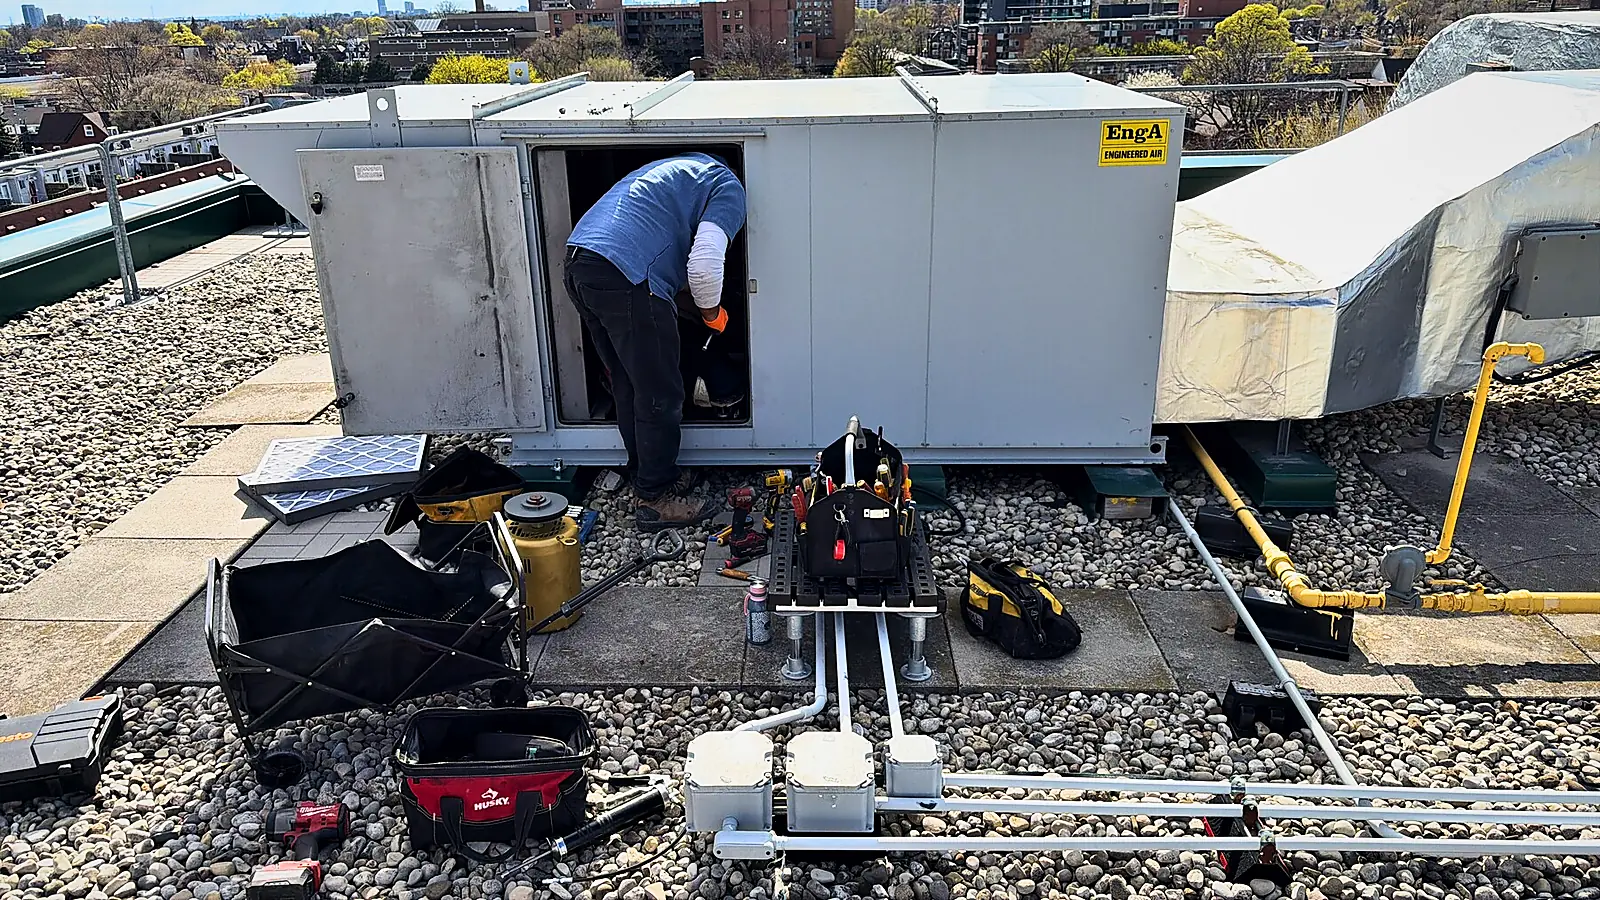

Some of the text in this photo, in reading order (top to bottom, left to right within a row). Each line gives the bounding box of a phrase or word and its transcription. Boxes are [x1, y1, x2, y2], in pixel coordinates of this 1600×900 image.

[1105, 123, 1163, 144] EngA
[1104, 149, 1163, 160] ENGINEERED AIR
[474, 797, 510, 811] HUSKY
